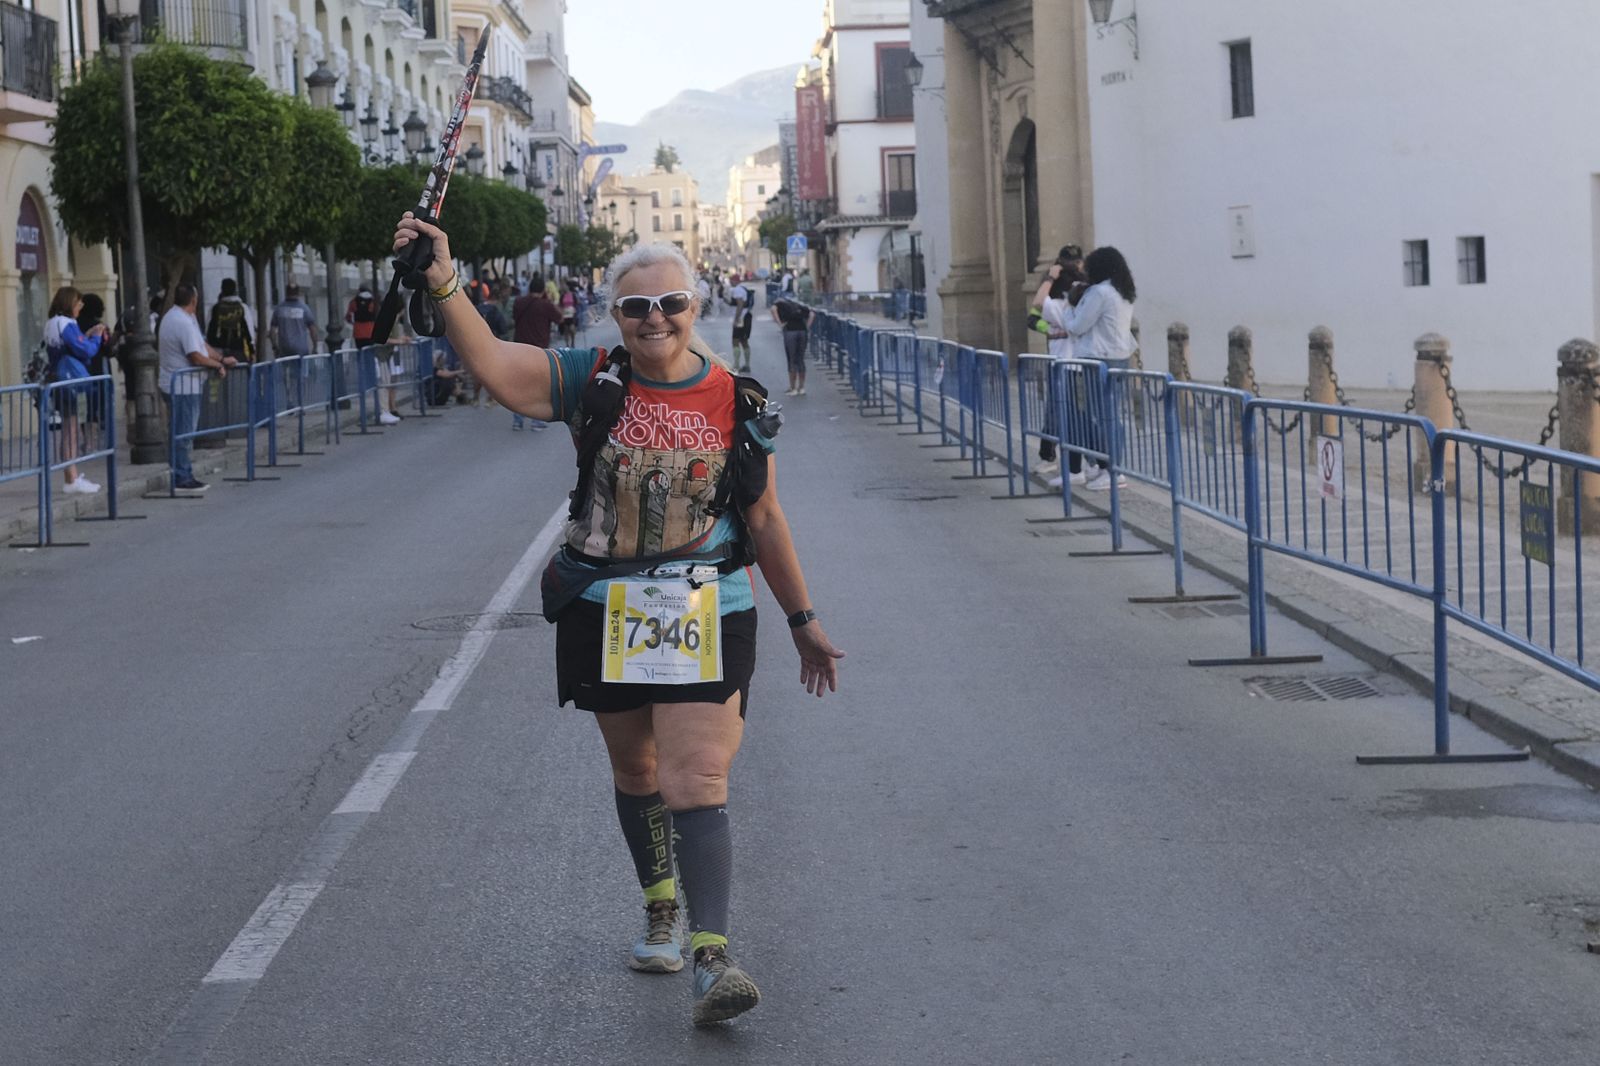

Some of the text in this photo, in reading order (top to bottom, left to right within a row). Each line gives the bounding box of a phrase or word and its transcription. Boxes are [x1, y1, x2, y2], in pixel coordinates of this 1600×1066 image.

[661, 593, 687, 602] Unicaja
[625, 616, 700, 650] 7346
[639, 803, 668, 876] kalenji
